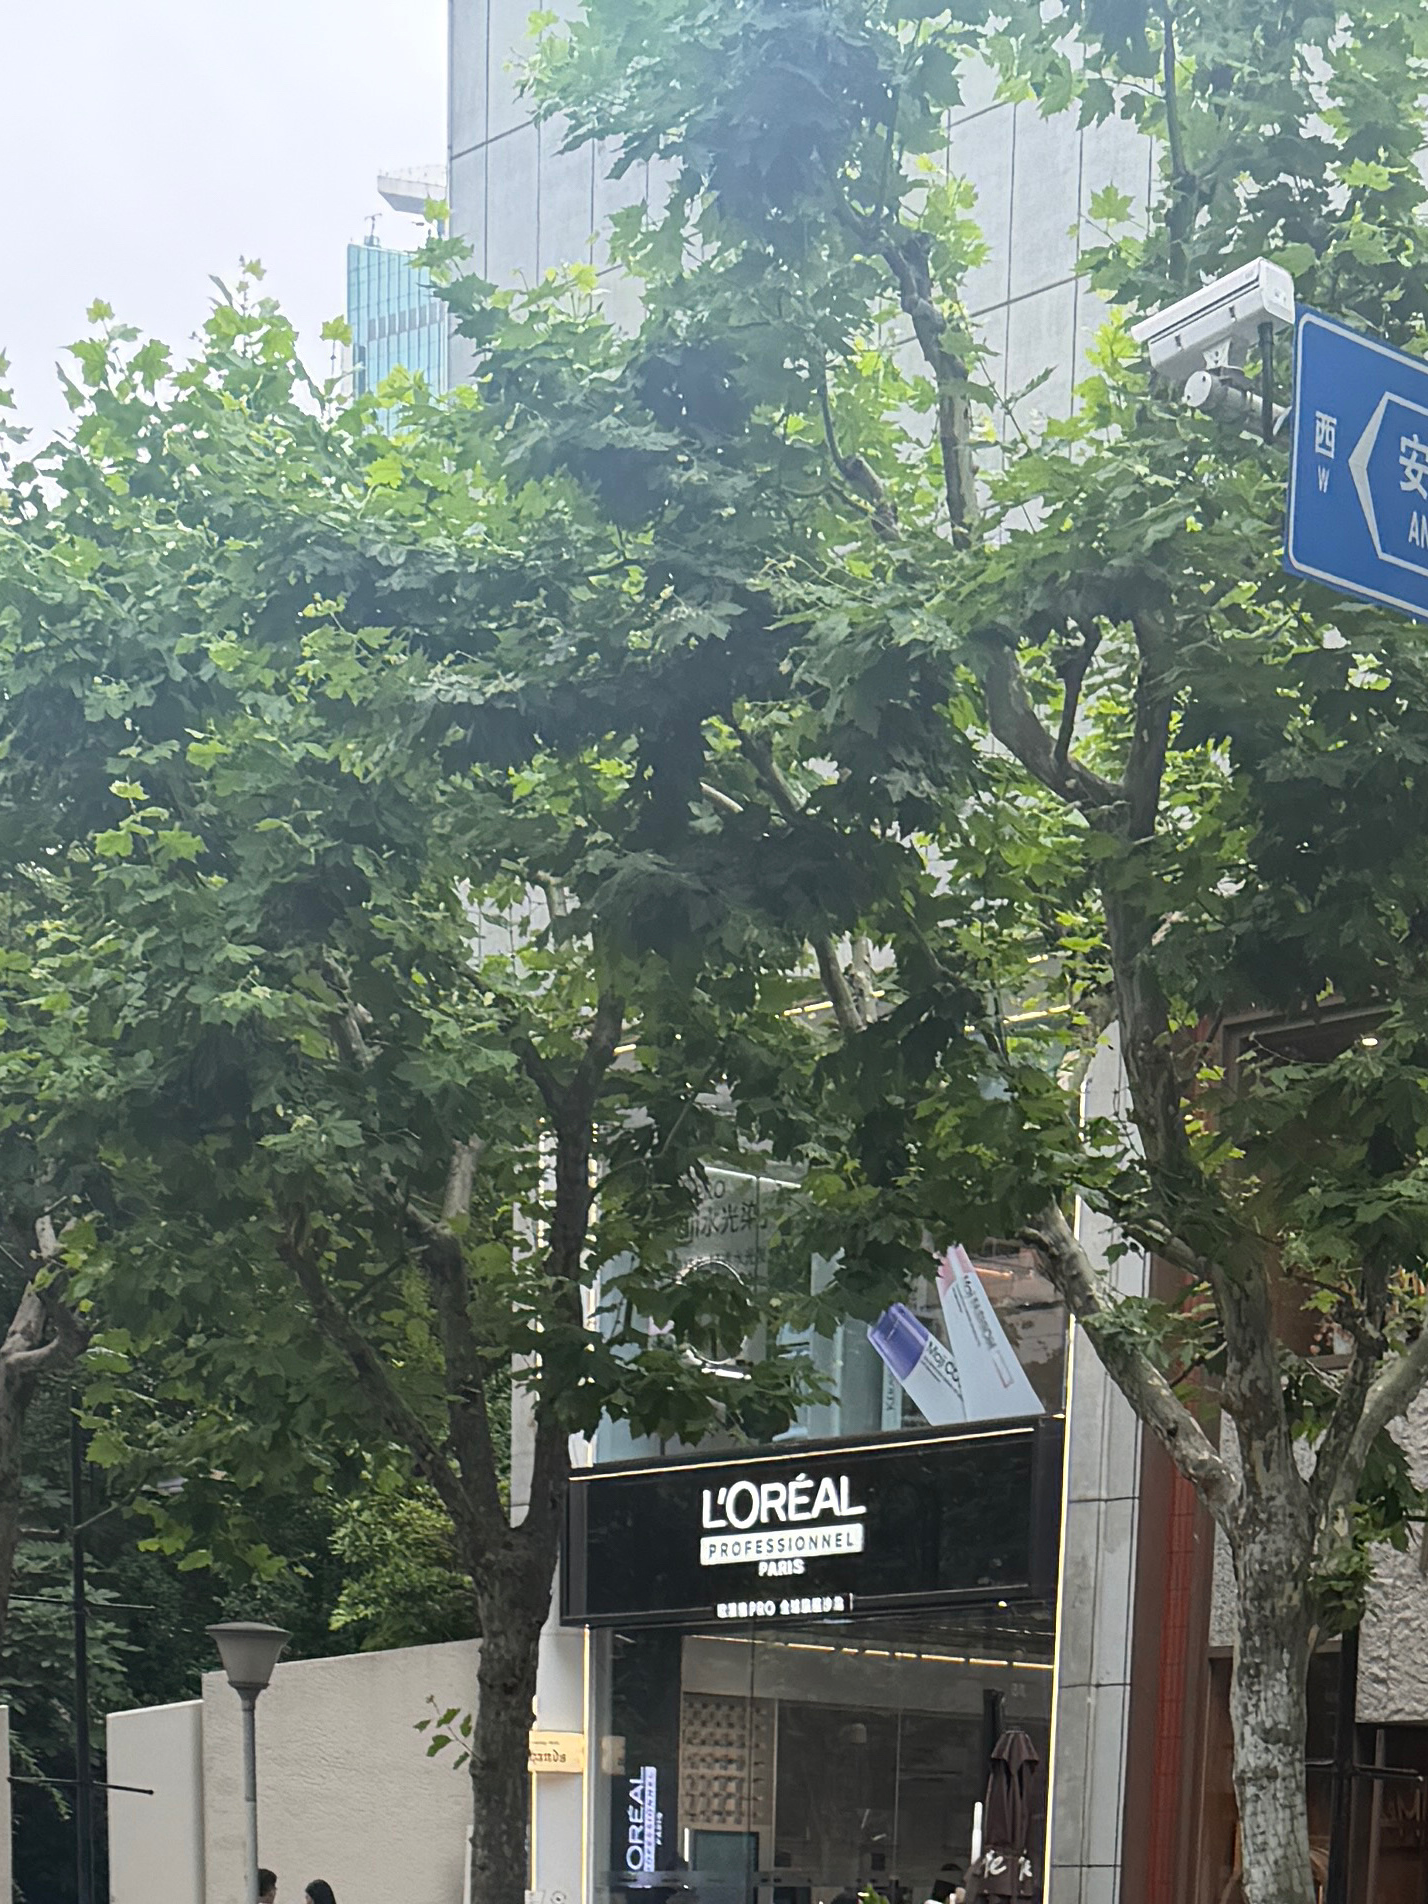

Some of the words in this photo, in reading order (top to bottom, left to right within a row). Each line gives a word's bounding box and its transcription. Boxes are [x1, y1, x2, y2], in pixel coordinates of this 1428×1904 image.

[1314, 410, 1337, 459] 西
[1317, 464, 1330, 494] W
[702, 1473, 867, 1529] L'ORÉAL
[709, 1532, 854, 1559] PROFESSIONNEL
[758, 1558, 806, 1577] PARIS
